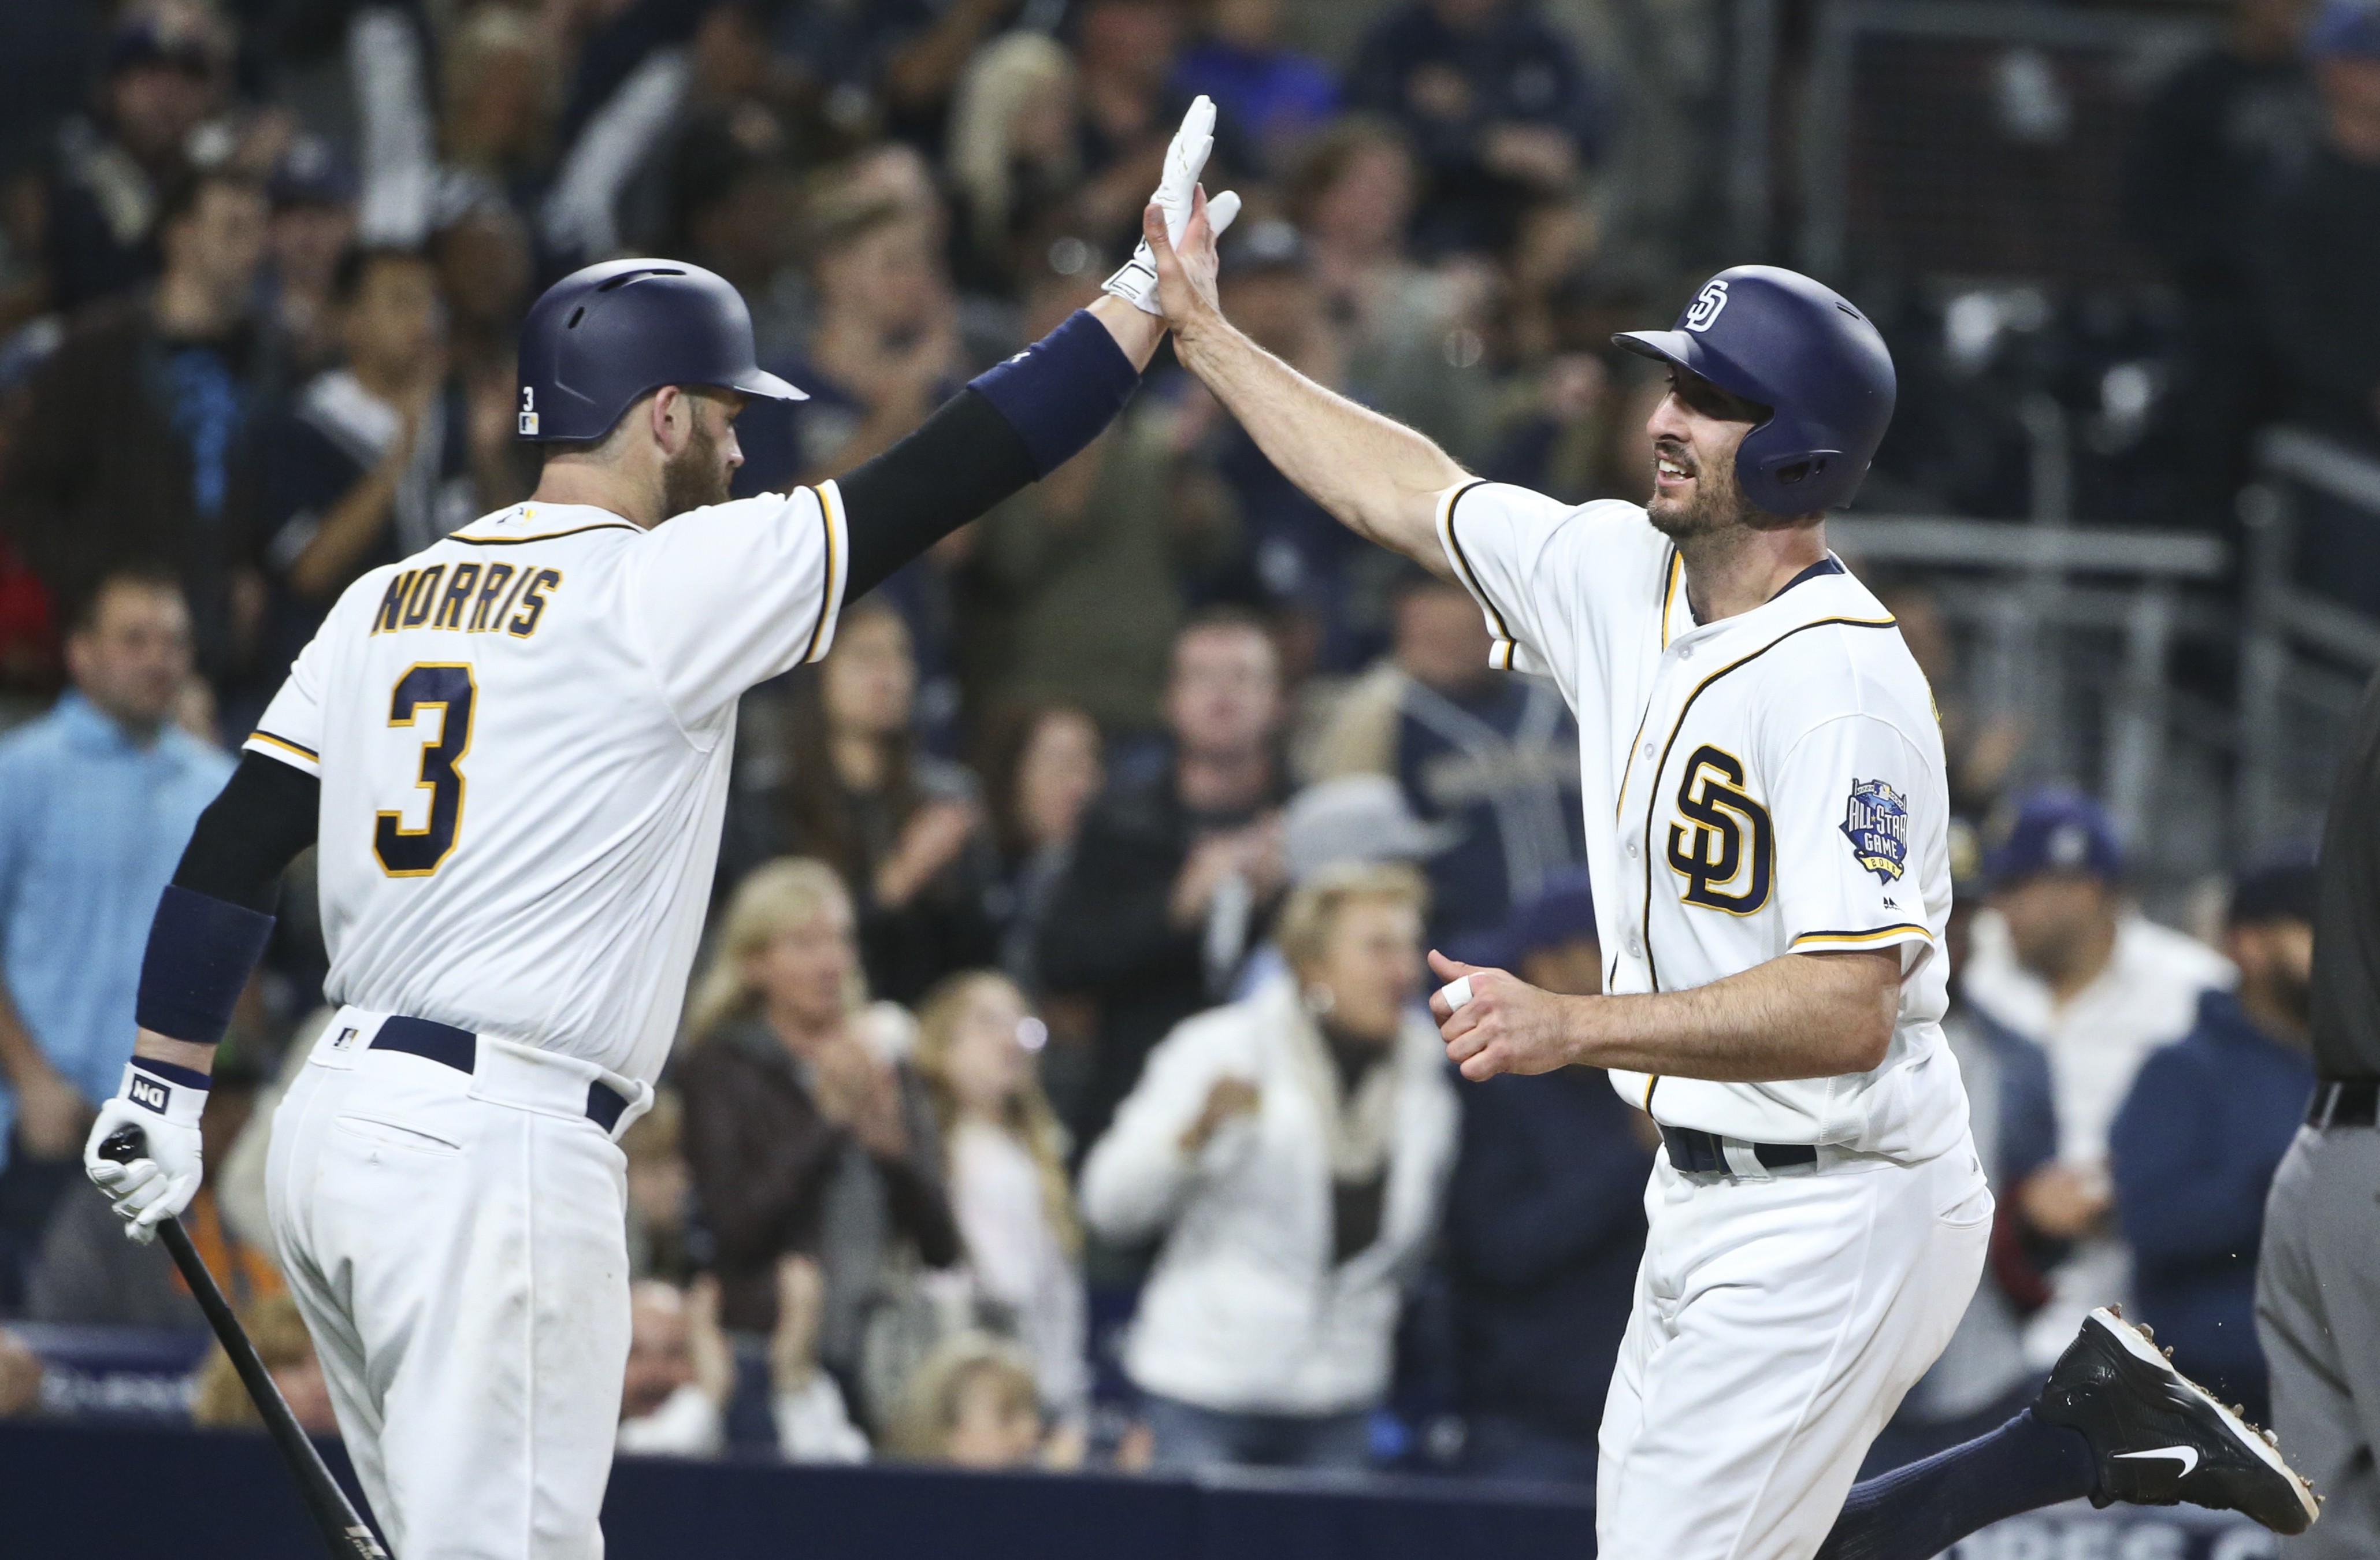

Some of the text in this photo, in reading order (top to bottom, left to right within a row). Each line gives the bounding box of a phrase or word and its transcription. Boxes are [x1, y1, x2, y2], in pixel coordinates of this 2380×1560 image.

[1684, 280, 1729, 332] SD
[523, 386, 533, 412] 3
[369, 561, 563, 639] NORRIS
[373, 661, 478, 878] 3
[1666, 743, 1773, 916] SD
[1864, 832, 1898, 860] GAME
[1870, 858, 1896, 874] 2016
